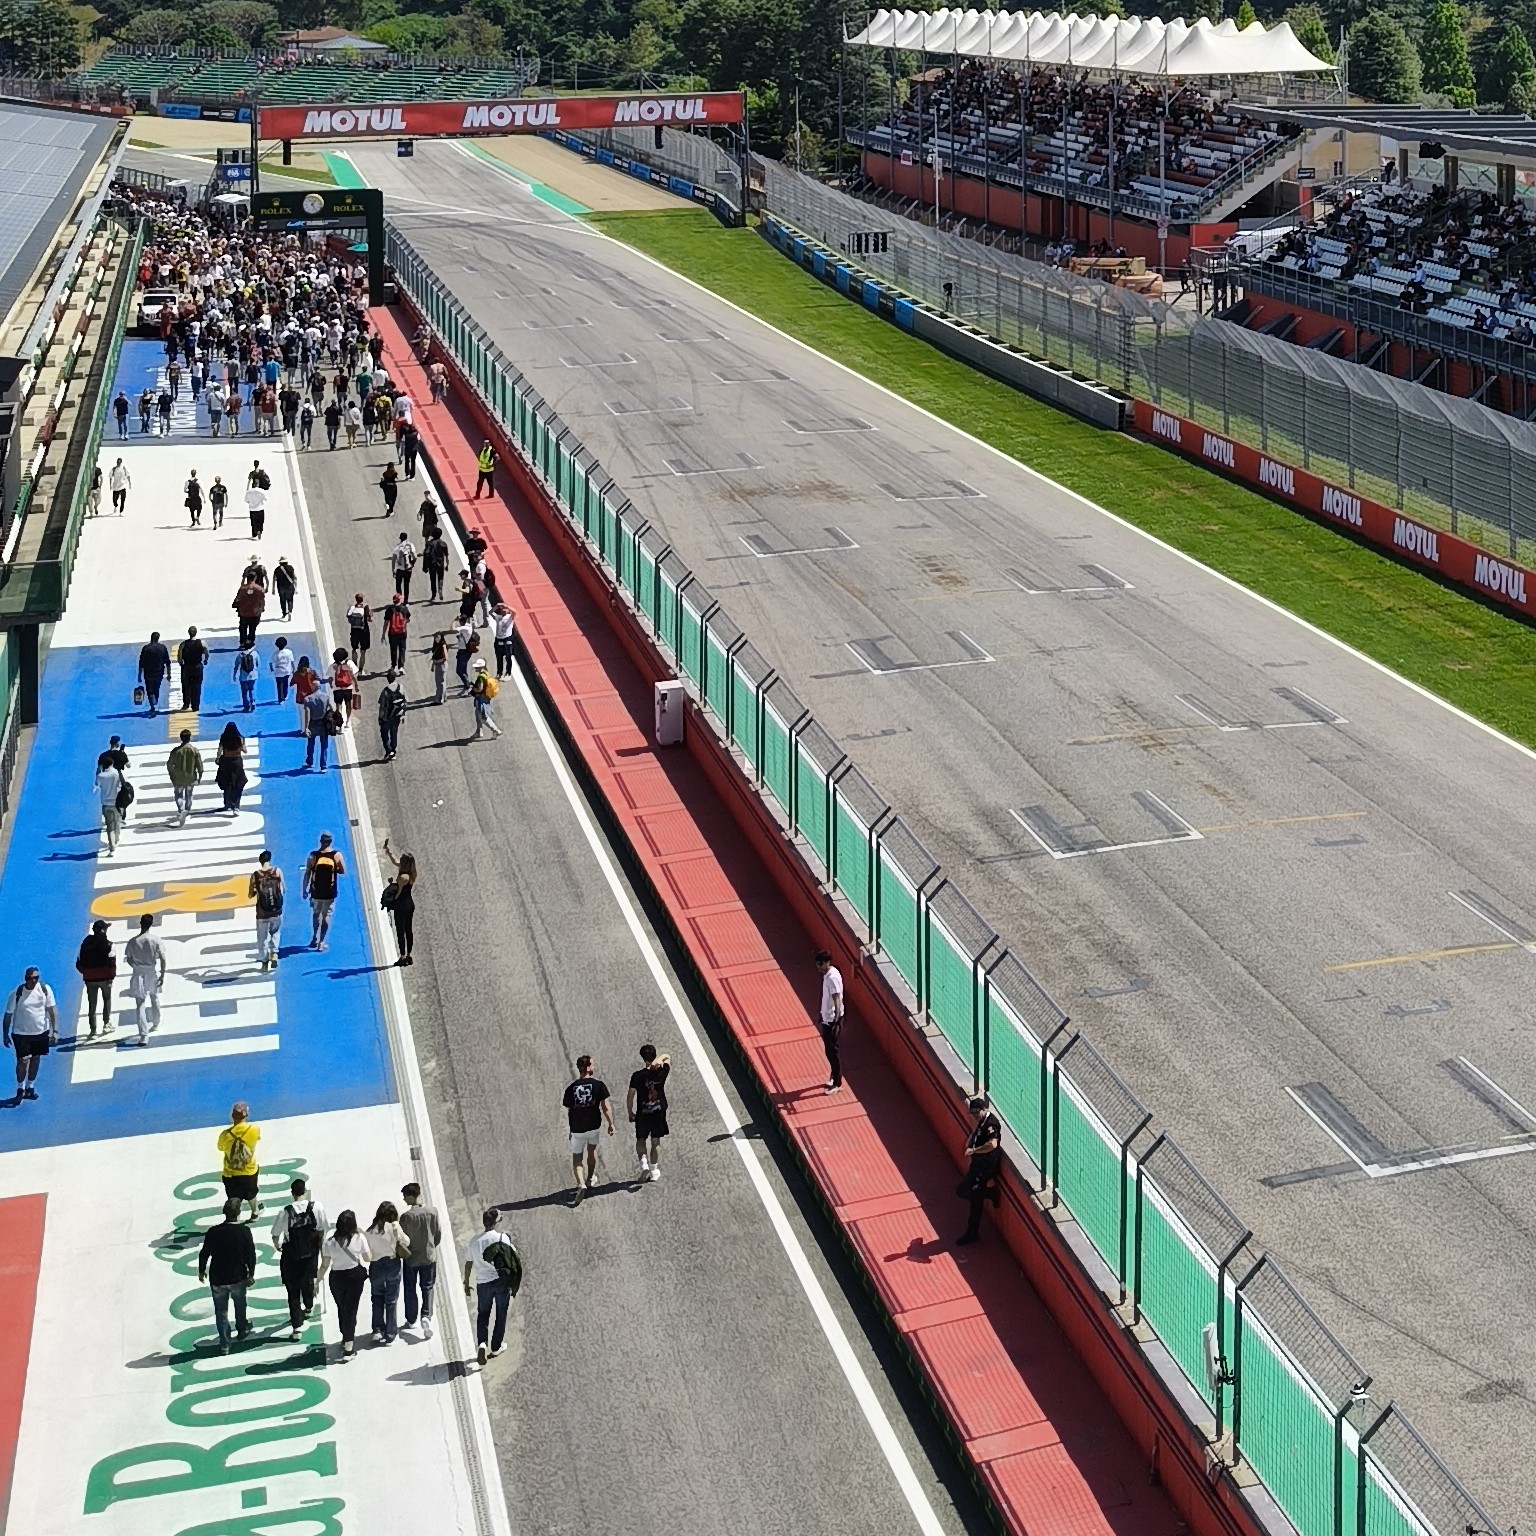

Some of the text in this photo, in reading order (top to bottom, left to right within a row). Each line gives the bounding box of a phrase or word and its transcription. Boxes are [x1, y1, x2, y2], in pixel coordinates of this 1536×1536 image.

[302, 108, 407, 133] MOTUL
[462, 103, 561, 128] MOTUL
[614, 98, 707, 122] MOTUL
[260, 207, 292, 215] ROLEX
[333, 204, 365, 212] ROLEX
[1152, 411, 1181, 443] MOTUL
[1203, 433, 1235, 467] MOTUL
[1259, 458, 1295, 495] MOTUL
[1322, 485, 1363, 526] MOTUL
[1393, 517, 1439, 563] MOTUL
[1474, 554, 1527, 603] MOTUL
